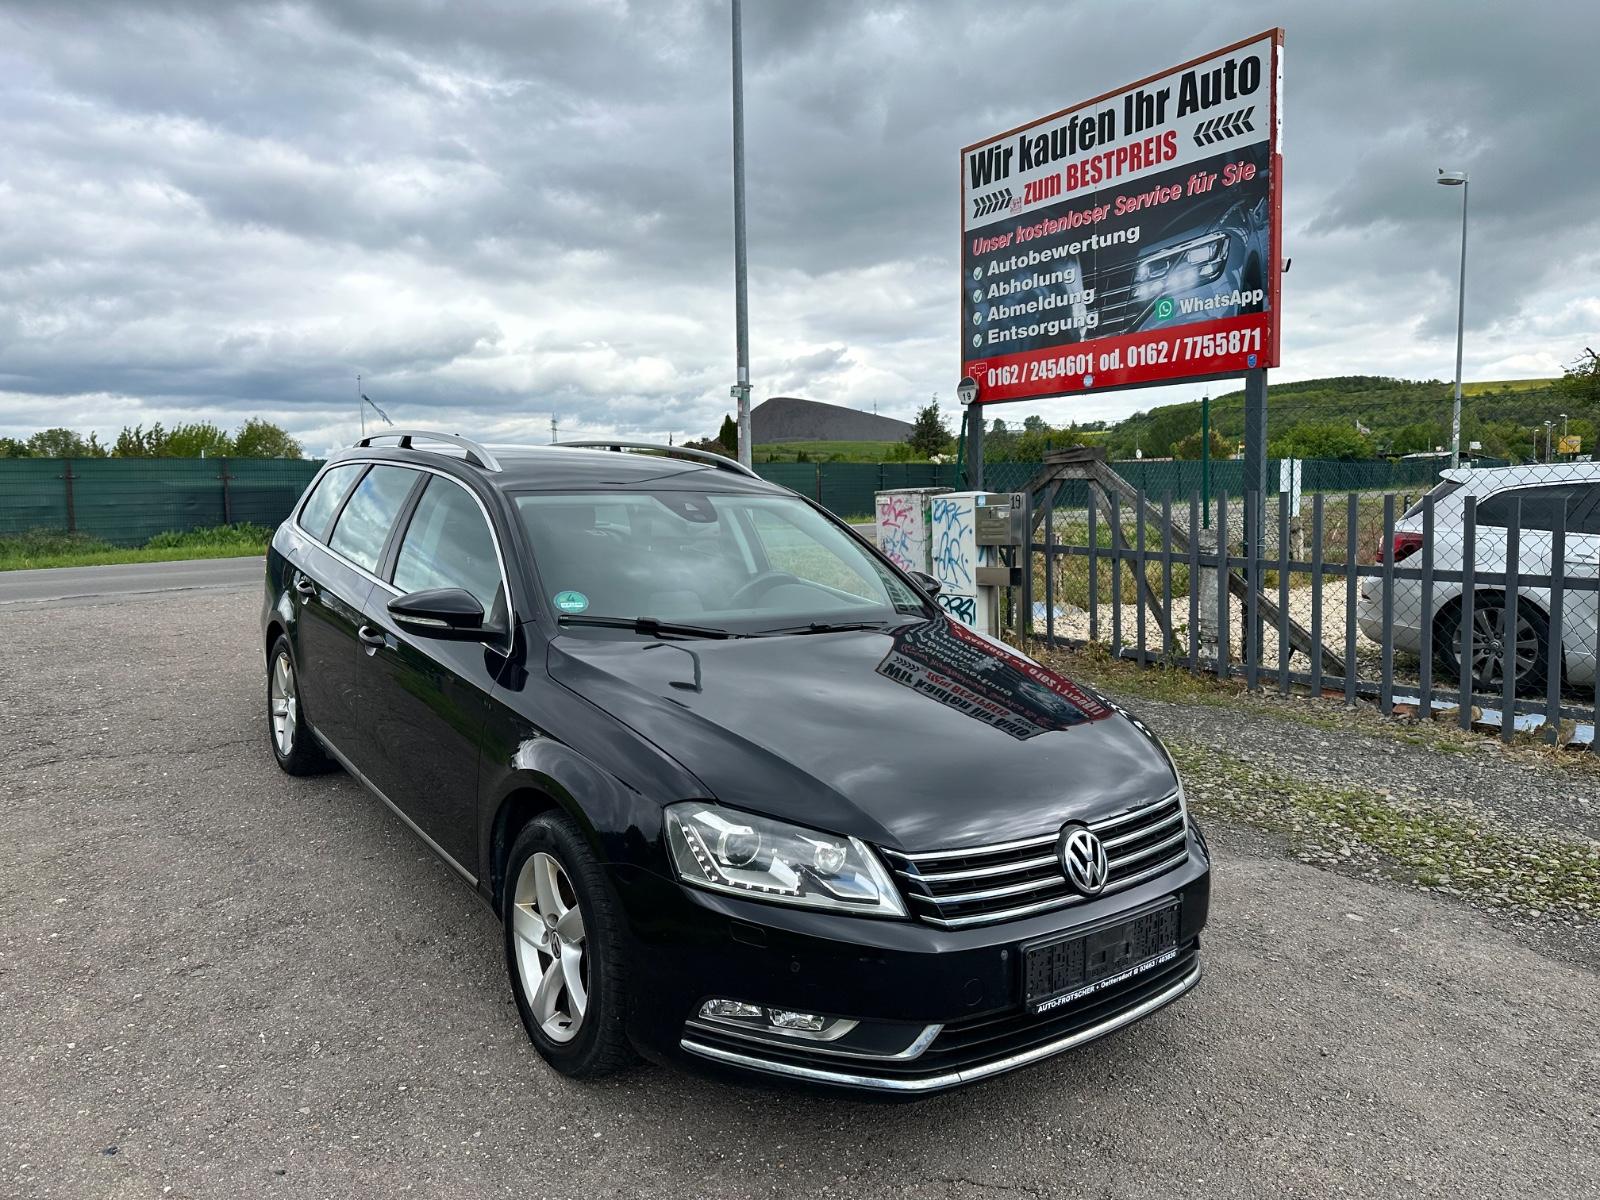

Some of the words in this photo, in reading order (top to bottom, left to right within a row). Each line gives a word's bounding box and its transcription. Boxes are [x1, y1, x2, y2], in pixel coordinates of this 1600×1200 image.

[970, 144, 1013, 189] Wir
[1018, 107, 1116, 173] kaufen
[1124, 85, 1171, 136] Ihr
[1176, 55, 1261, 118] Auto
[1023, 172, 1061, 205] zum
[1066, 129, 1177, 192] BESTPREIS
[972, 233, 1013, 256] Unser
[1016, 203, 1111, 245] kostenloser
[1114, 183, 1182, 217] Service
[1186, 170, 1217, 197] für
[1221, 160, 1257, 186] Sie
[987, 225, 1140, 276] Autobewertung
[987, 267, 1076, 299] Abholung
[987, 287, 1096, 322] Abmeldung
[1179, 288, 1264, 314] WhatsApp
[987, 311, 1099, 344] Entsorgung
[987, 364, 1019, 388] 0162
[1030, 352, 1094, 382] 2454601
[1099, 350, 1124, 372] od.
[1127, 340, 1169, 367] 0162
[1184, 327, 1261, 360] 7755871
[1010, 494, 1021, 510] 19
[1037, 985, 1095, 1014] AUTO-FROTSCHER
